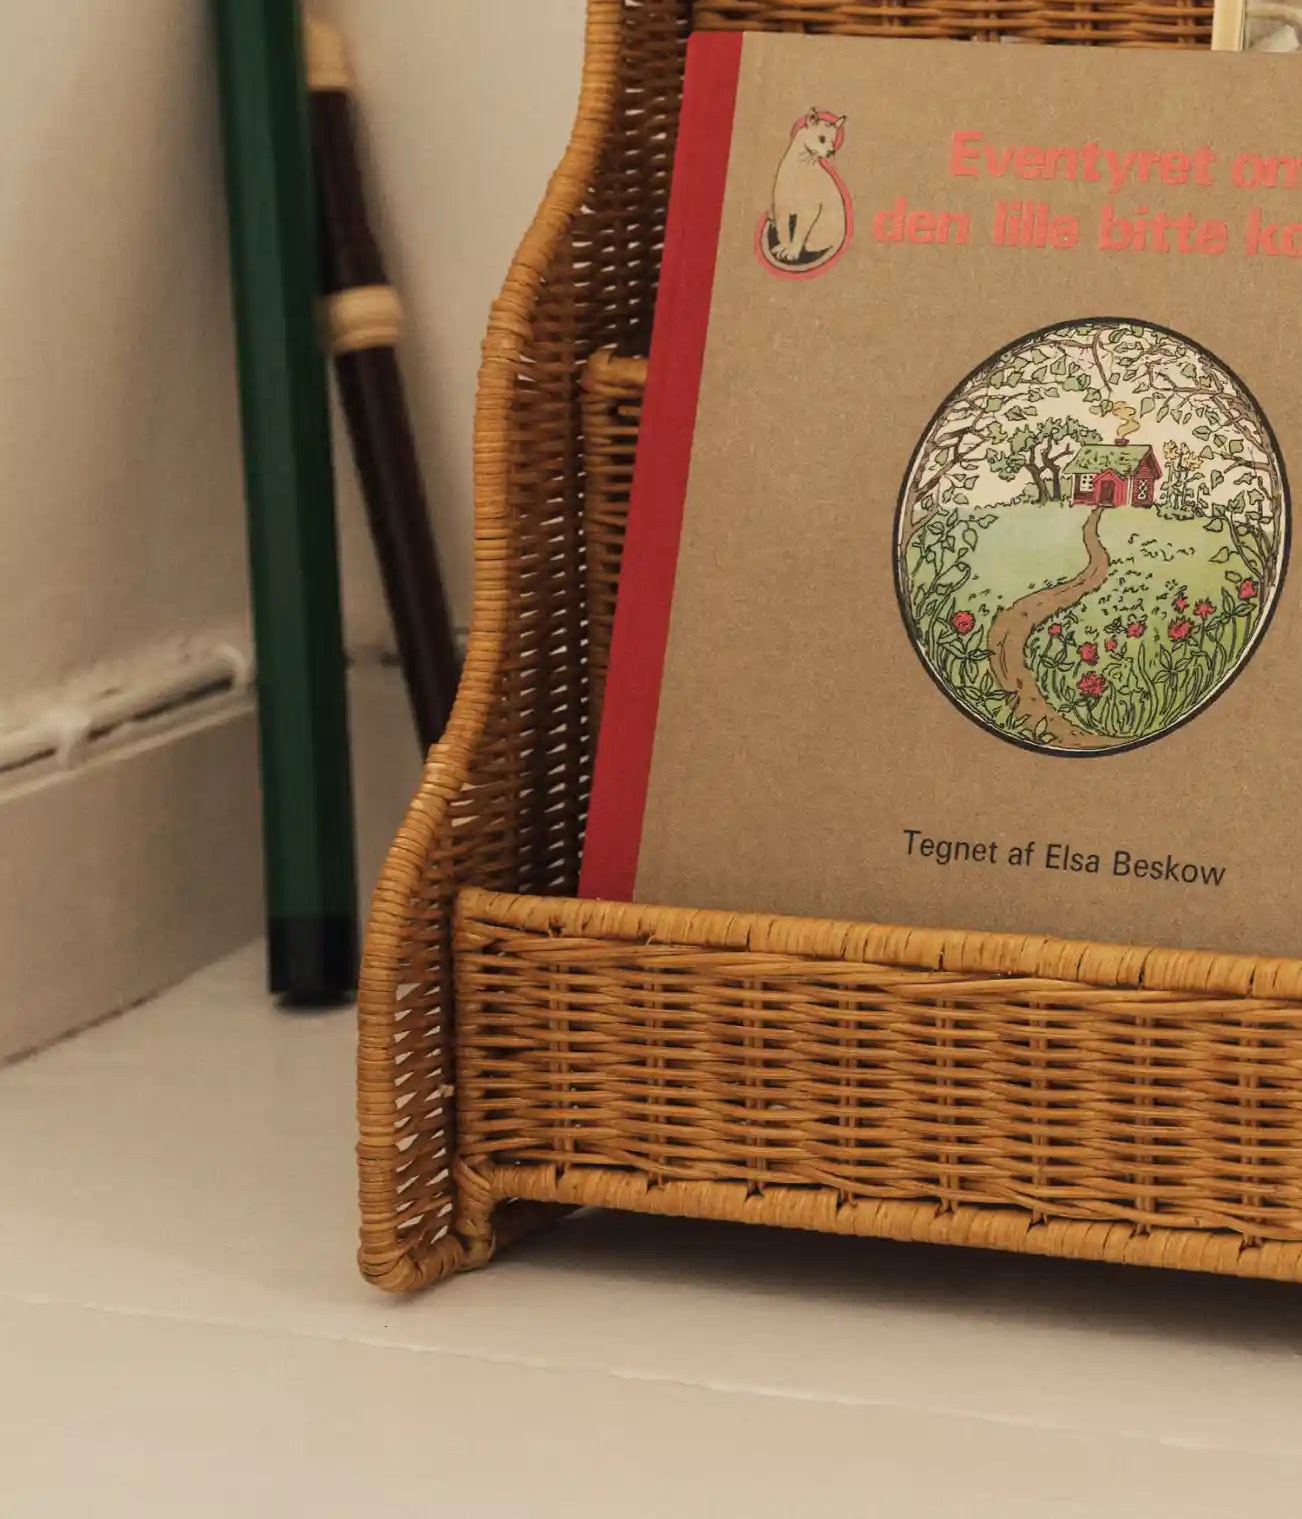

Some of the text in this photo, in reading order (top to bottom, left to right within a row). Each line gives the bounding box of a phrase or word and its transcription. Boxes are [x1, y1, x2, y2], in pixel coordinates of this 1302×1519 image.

[947, 129, 1217, 194] Eventyret
[871, 196, 971, 247] den
[991, 199, 1081, 250] lille
[1097, 203, 1230, 255] bitte
[903, 829, 1227, 887] Tegnet af Elsa Beskow
